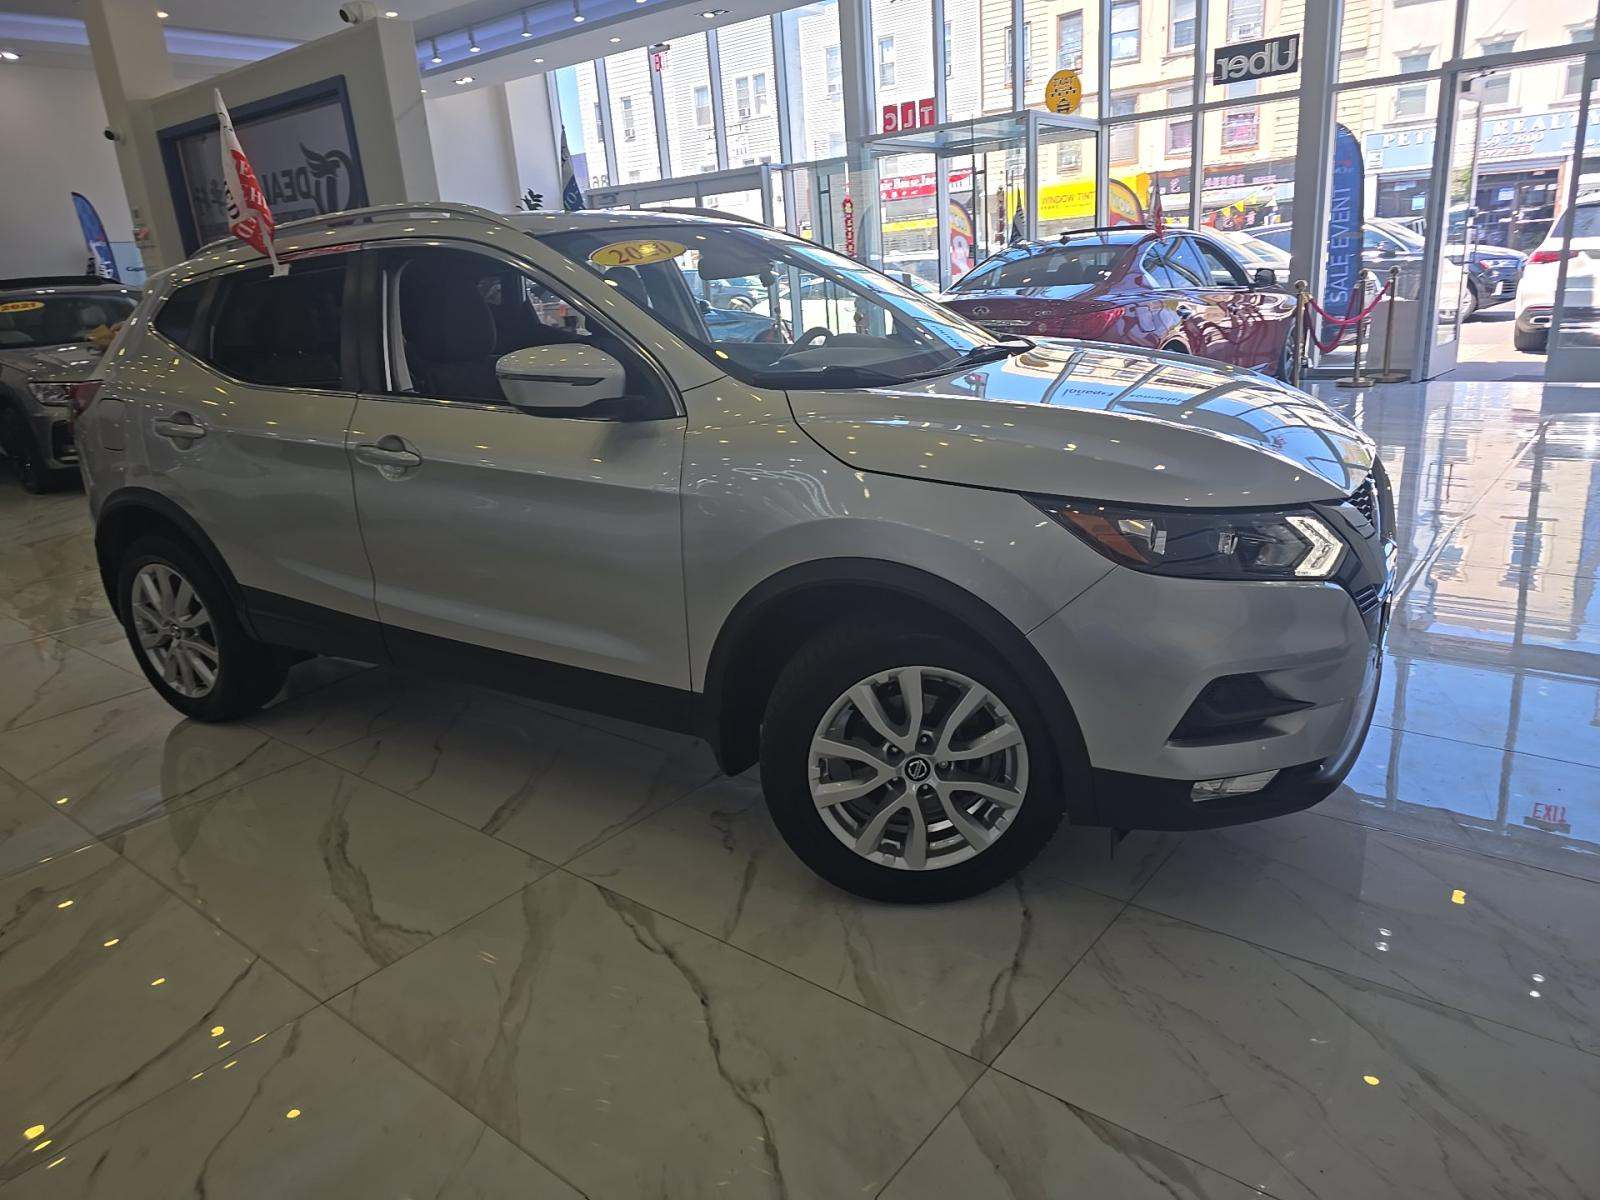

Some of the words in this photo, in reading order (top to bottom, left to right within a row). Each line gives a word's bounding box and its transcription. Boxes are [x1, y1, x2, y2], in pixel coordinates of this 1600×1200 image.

[1331, 187, 1351, 250] EVENT
[608, 241, 672, 264] 200
[1330, 254, 1350, 304] SALE
